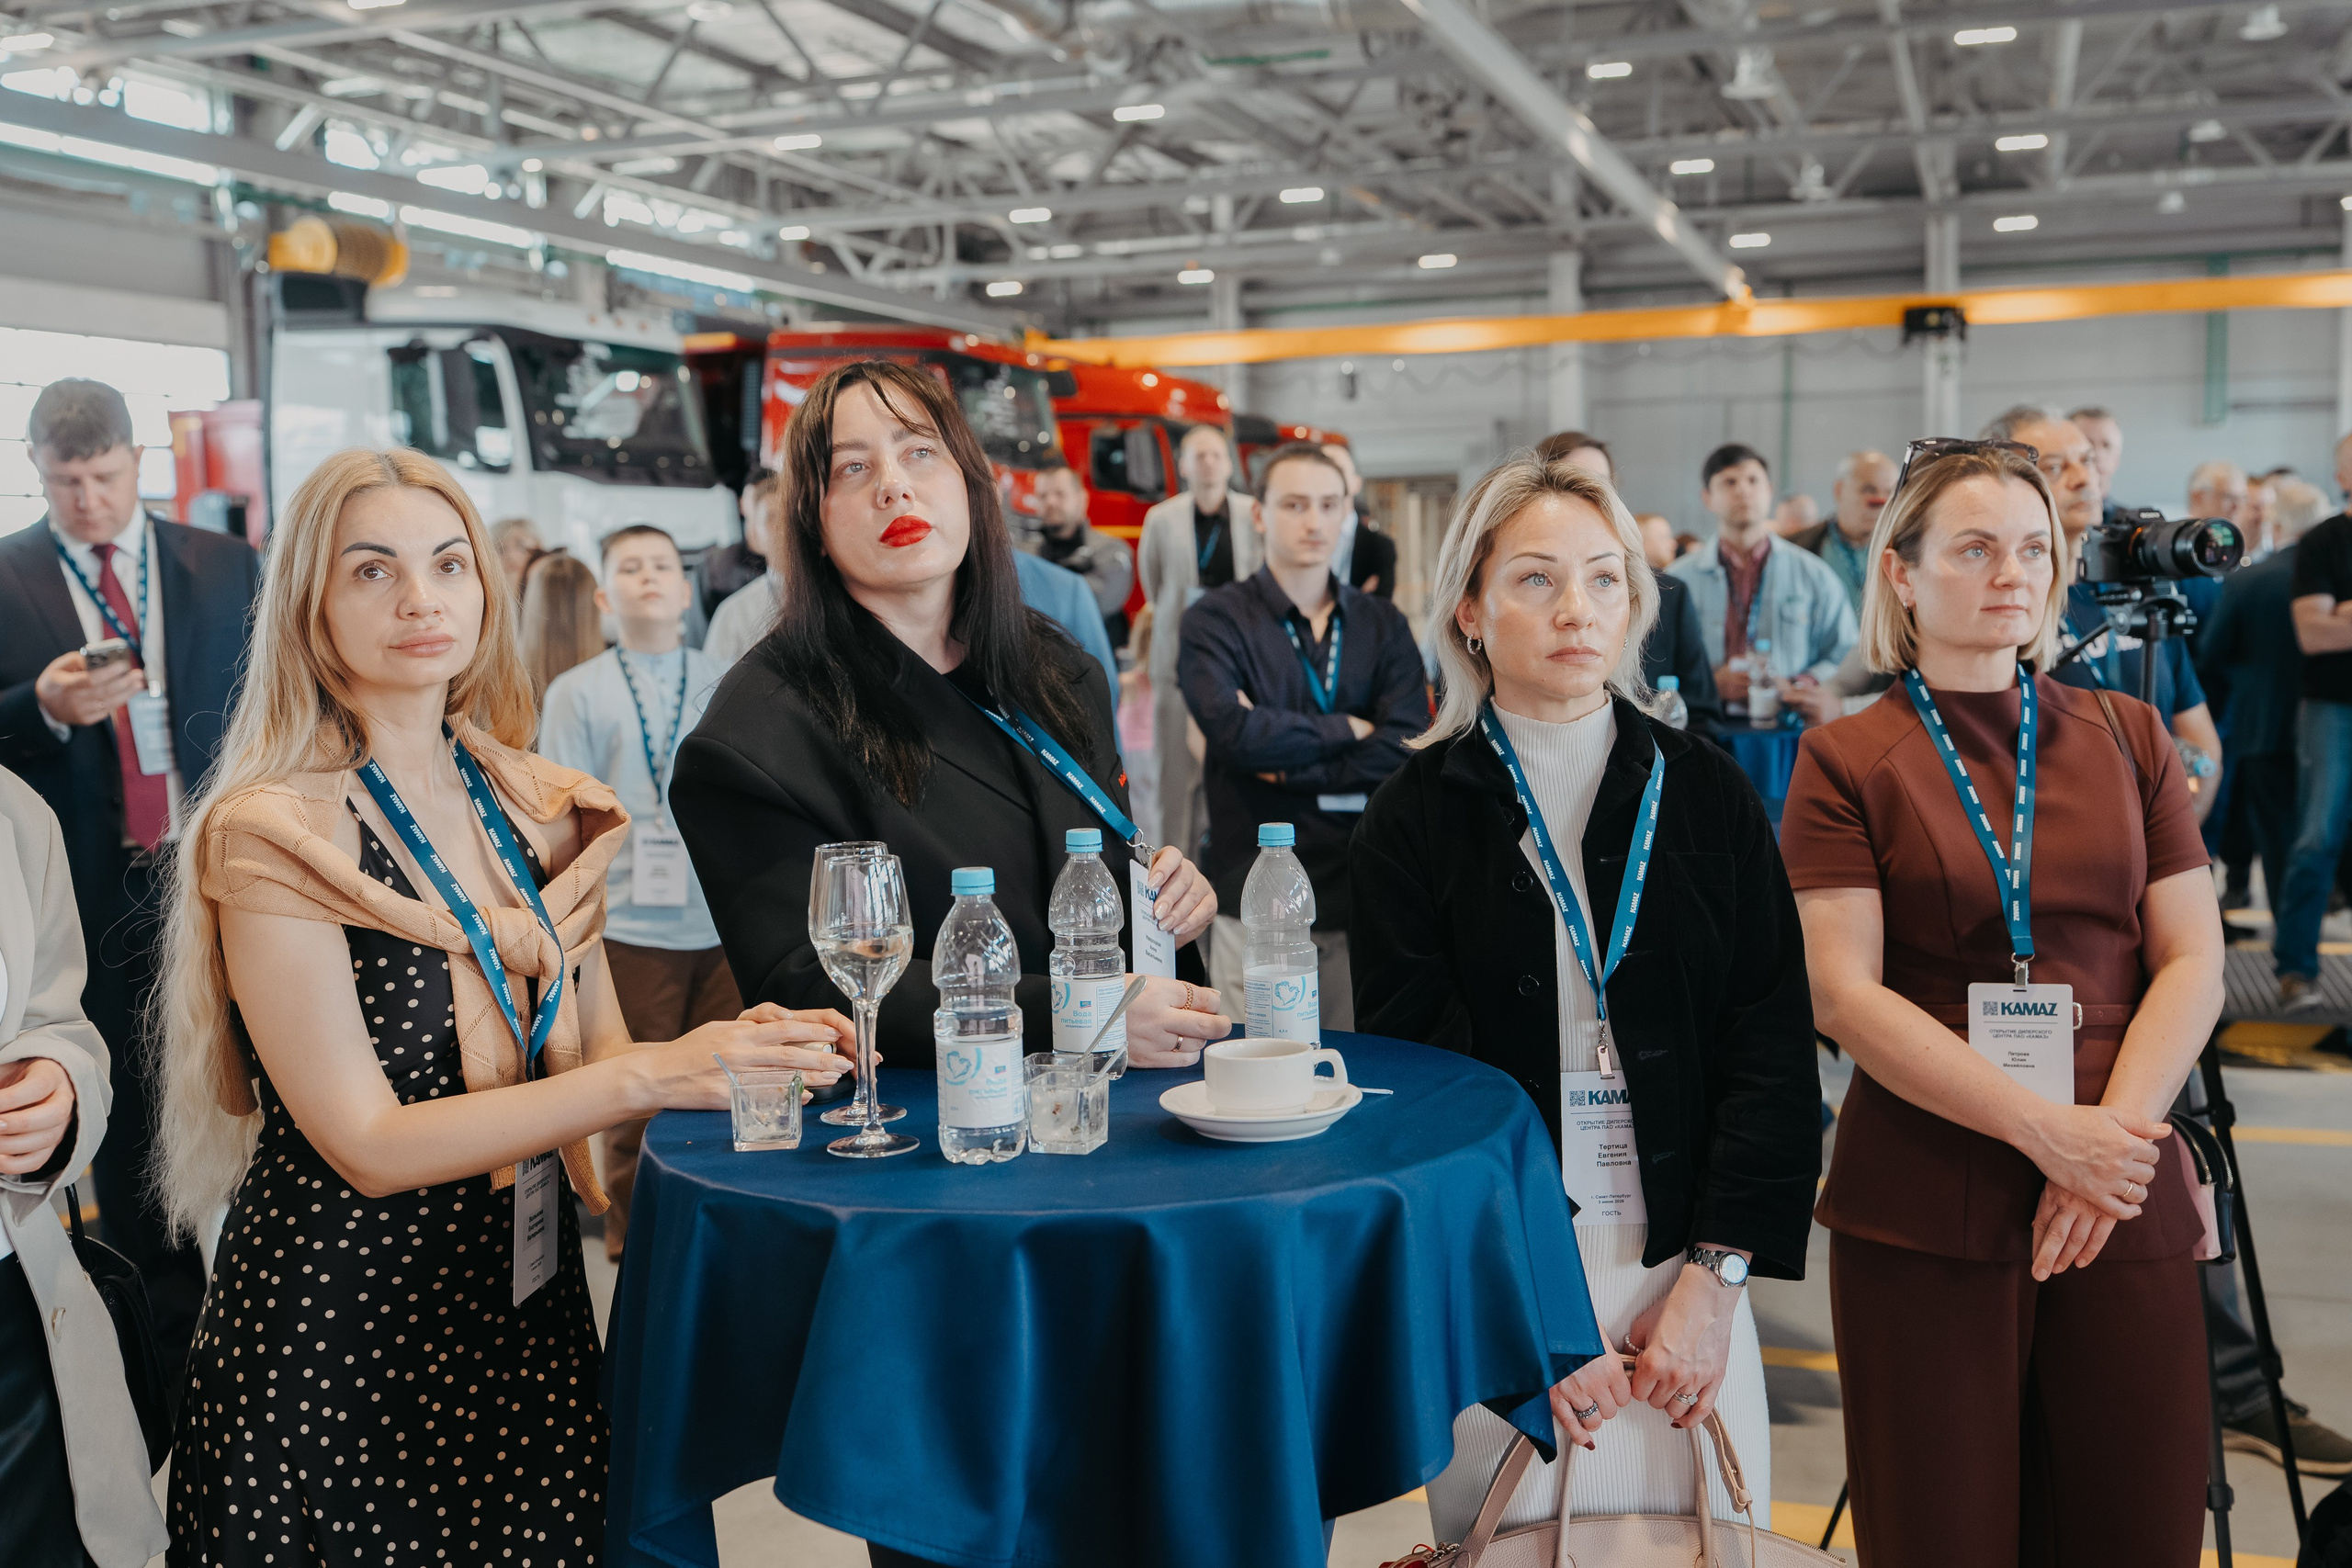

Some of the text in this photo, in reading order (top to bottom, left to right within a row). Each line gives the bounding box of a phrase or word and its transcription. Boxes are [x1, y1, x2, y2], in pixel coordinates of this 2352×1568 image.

[1041, 749, 1059, 766] KAMAZ
[1491, 739, 1505, 757] KAMAZ
[368, 761, 387, 784] KAMAZ
[460, 767, 473, 789] KAMAZ
[1066, 772, 1084, 790] KAMAZ
[1507, 764, 1520, 784] KAMAZ
[390, 793, 407, 814] KAMAZ
[474, 797, 488, 819] KAMAZ
[1090, 796, 1106, 815] KAMAZ
[1521, 795, 1532, 815] KAMAZ
[1649, 800, 1657, 820] KAMAZ
[410, 823, 427, 844] KAMAZ
[488, 828, 503, 849] KAMAZ
[1532, 827, 1544, 848] KAMAZ
[1644, 830, 1653, 851] KAMAZ
[430, 853, 447, 874] KAMAZ
[503, 858, 518, 878] KAMAZ
[1544, 860, 1555, 881] KAMAZ
[1636, 861, 1646, 882] KAMAZ
[450, 882, 469, 903] KAMAZ
[1555, 892, 1569, 913] KAMAZ
[1630, 892, 1640, 914] KAMAZ
[471, 913, 489, 936] KAMAZ
[1568, 925, 1580, 947] KAMAZ
[1622, 925, 1633, 948] KAMAZ
[489, 947, 502, 971] KAMAZ
[502, 982, 512, 1005] KAMAZ
[546, 979, 560, 1003] KAMAZ
[2001, 1002, 2058, 1016] KAMAZ
[530, 1013, 544, 1037] KAMAZ
[1588, 1089, 1631, 1105] KAM
[1599, 1143, 1628, 1151] Тертица
[1596, 1159, 1632, 1168] Павловна
